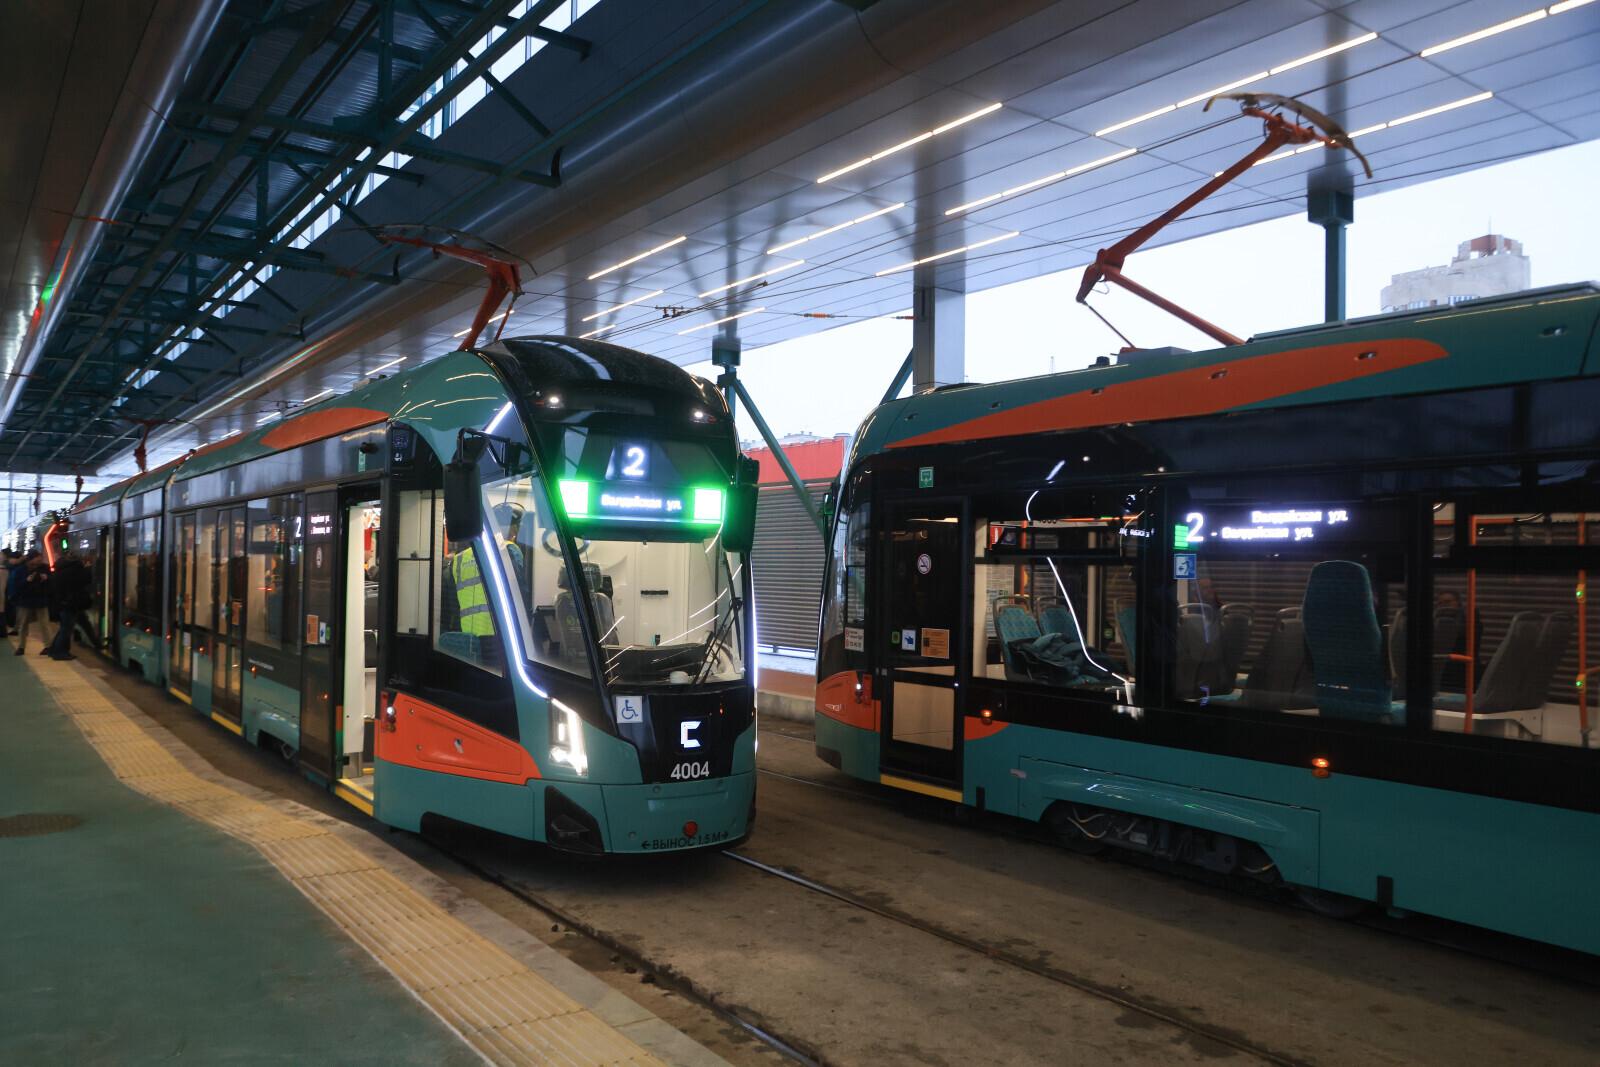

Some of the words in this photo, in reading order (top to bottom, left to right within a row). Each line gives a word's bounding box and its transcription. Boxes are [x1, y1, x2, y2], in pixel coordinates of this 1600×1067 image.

[622, 446, 646, 477] 2
[294, 516, 302, 538] 2
[1184, 511, 1205, 543] 2
[670, 761, 710, 780] 4004
[652, 836, 696, 849] ВЫНОС
